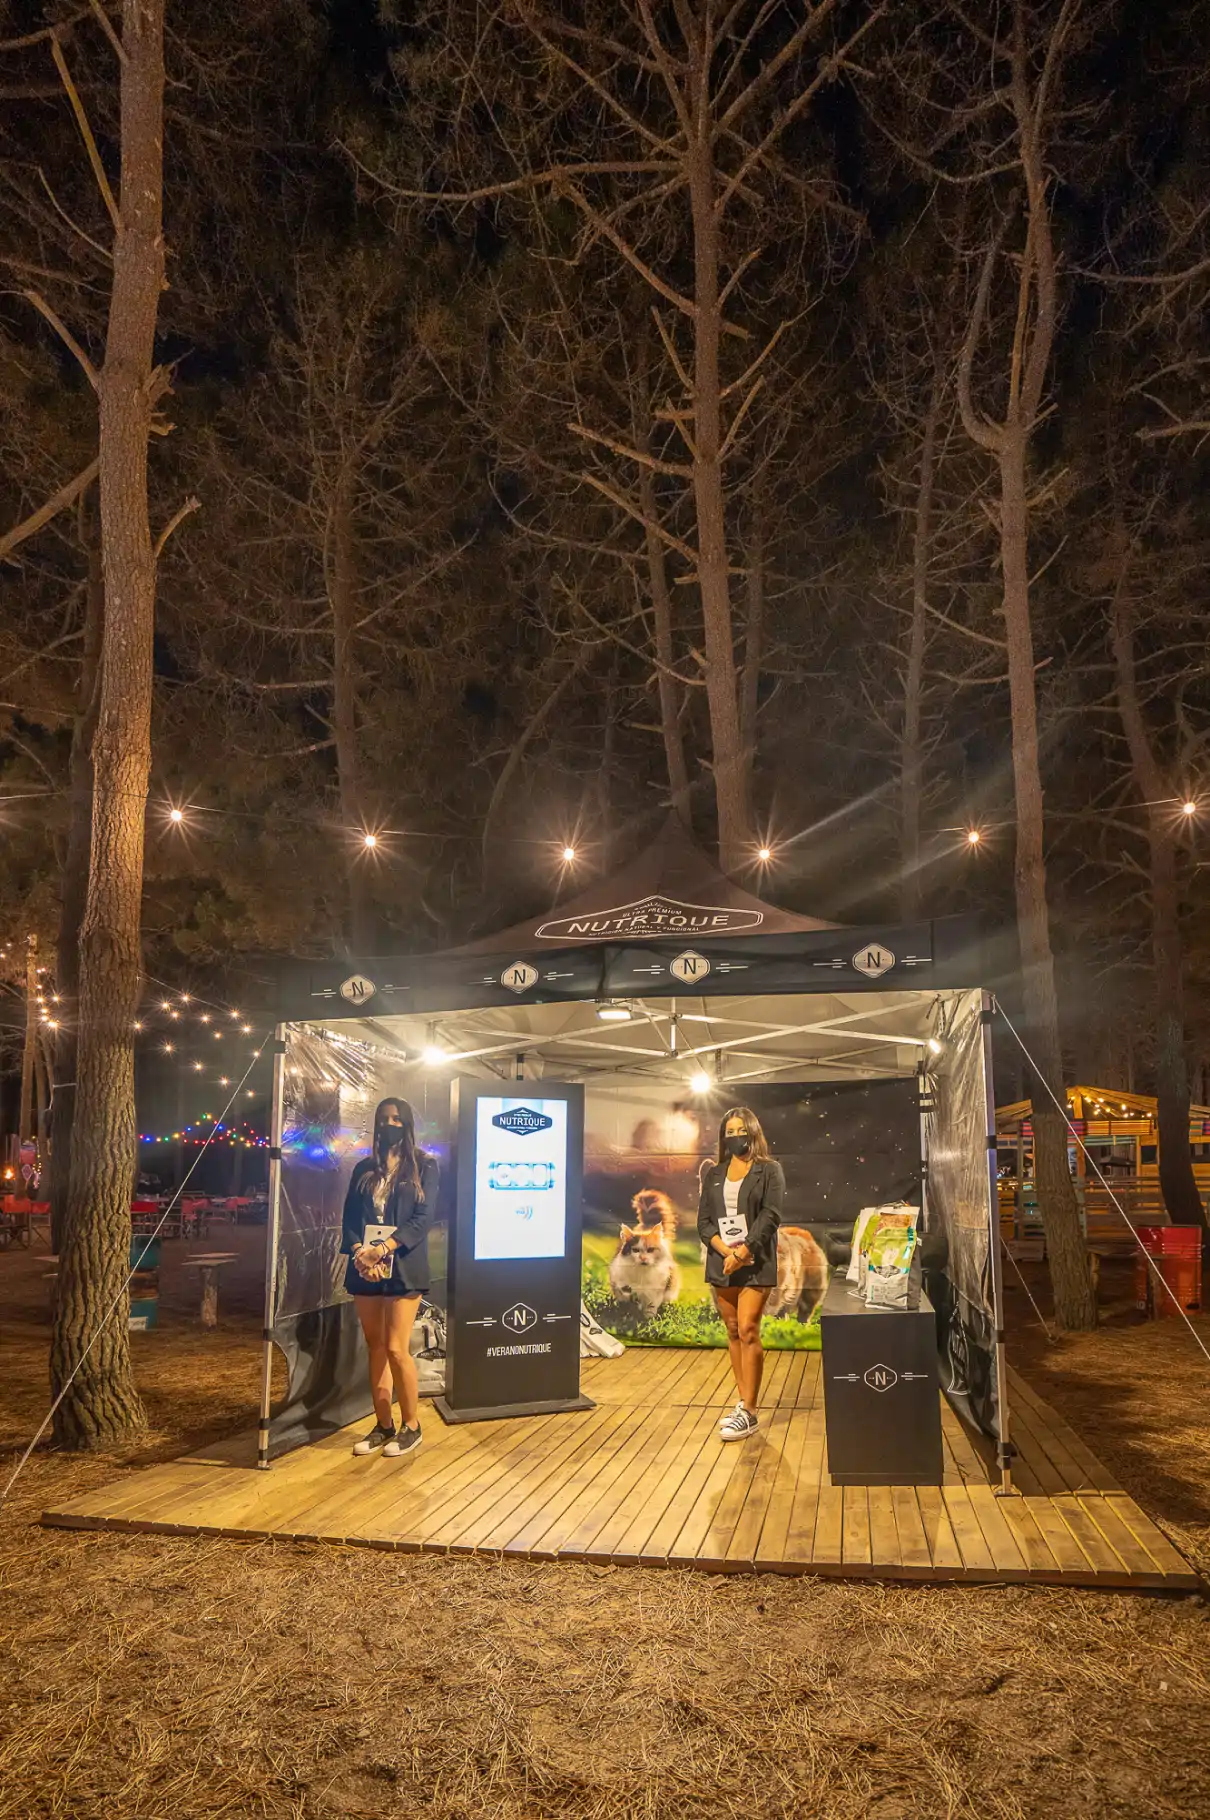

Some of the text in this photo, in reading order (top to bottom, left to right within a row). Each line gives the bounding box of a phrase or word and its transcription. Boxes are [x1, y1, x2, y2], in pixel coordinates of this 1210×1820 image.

[648, 907, 682, 915] PREMIUM
[567, 913, 730, 933] NUTRIQUE
[684, 958, 696, 975] N
[867, 951, 881, 968] N
[514, 969, 527, 985] N
[352, 981, 365, 997] N
[499, 1116, 546, 1127] NUTRIQUE
[513, 1309, 526, 1326] N
[487, 1342, 551, 1357] #VERANONUTRIQUE
[875, 1371, 886, 1386] N
